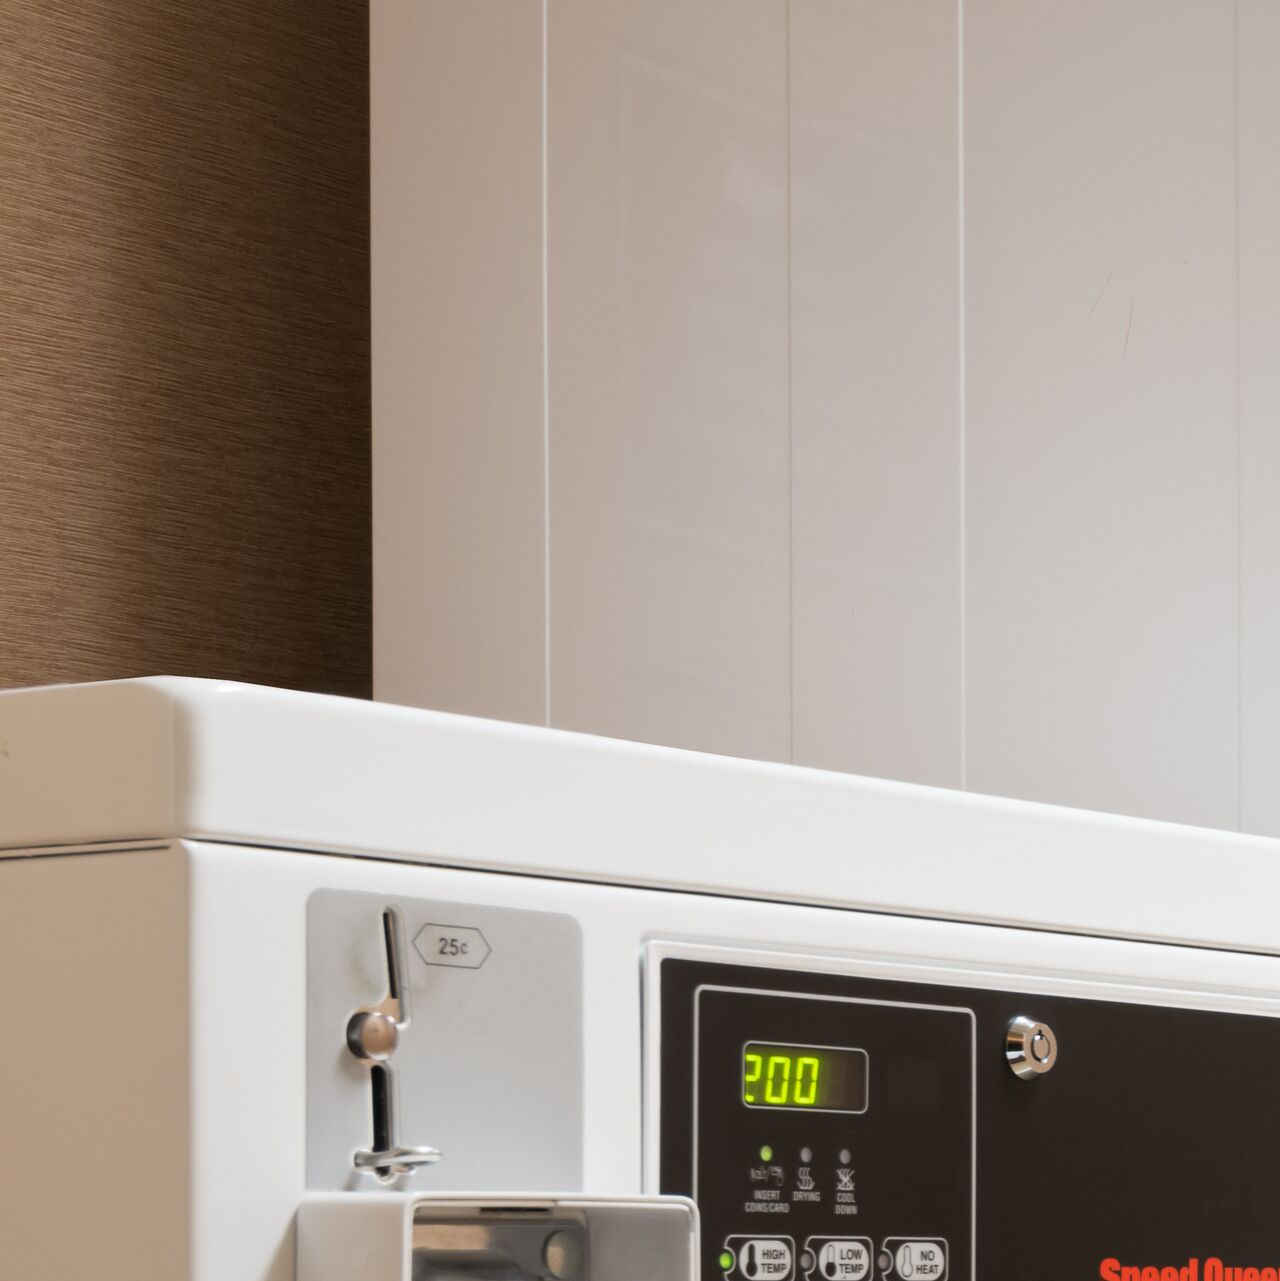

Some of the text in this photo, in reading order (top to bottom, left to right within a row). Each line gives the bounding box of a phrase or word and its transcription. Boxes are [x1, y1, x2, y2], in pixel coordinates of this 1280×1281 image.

[753, 1190, 780, 1201] INSERT
[792, 1191, 821, 1202] DRYING
[836, 1192, 856, 1203] COOL
[744, 1202, 790, 1213] COINS/CARD
[834, 1204, 858, 1215] DOWN
[761, 1249, 786, 1260] HIGH
[839, 1249, 864, 1261] LOW
[920, 1250, 936, 1261] NO
[760, 1263, 787, 1274] TEMP
[838, 1263, 865, 1275] TEMP
[915, 1264, 939, 1275] HEAT
